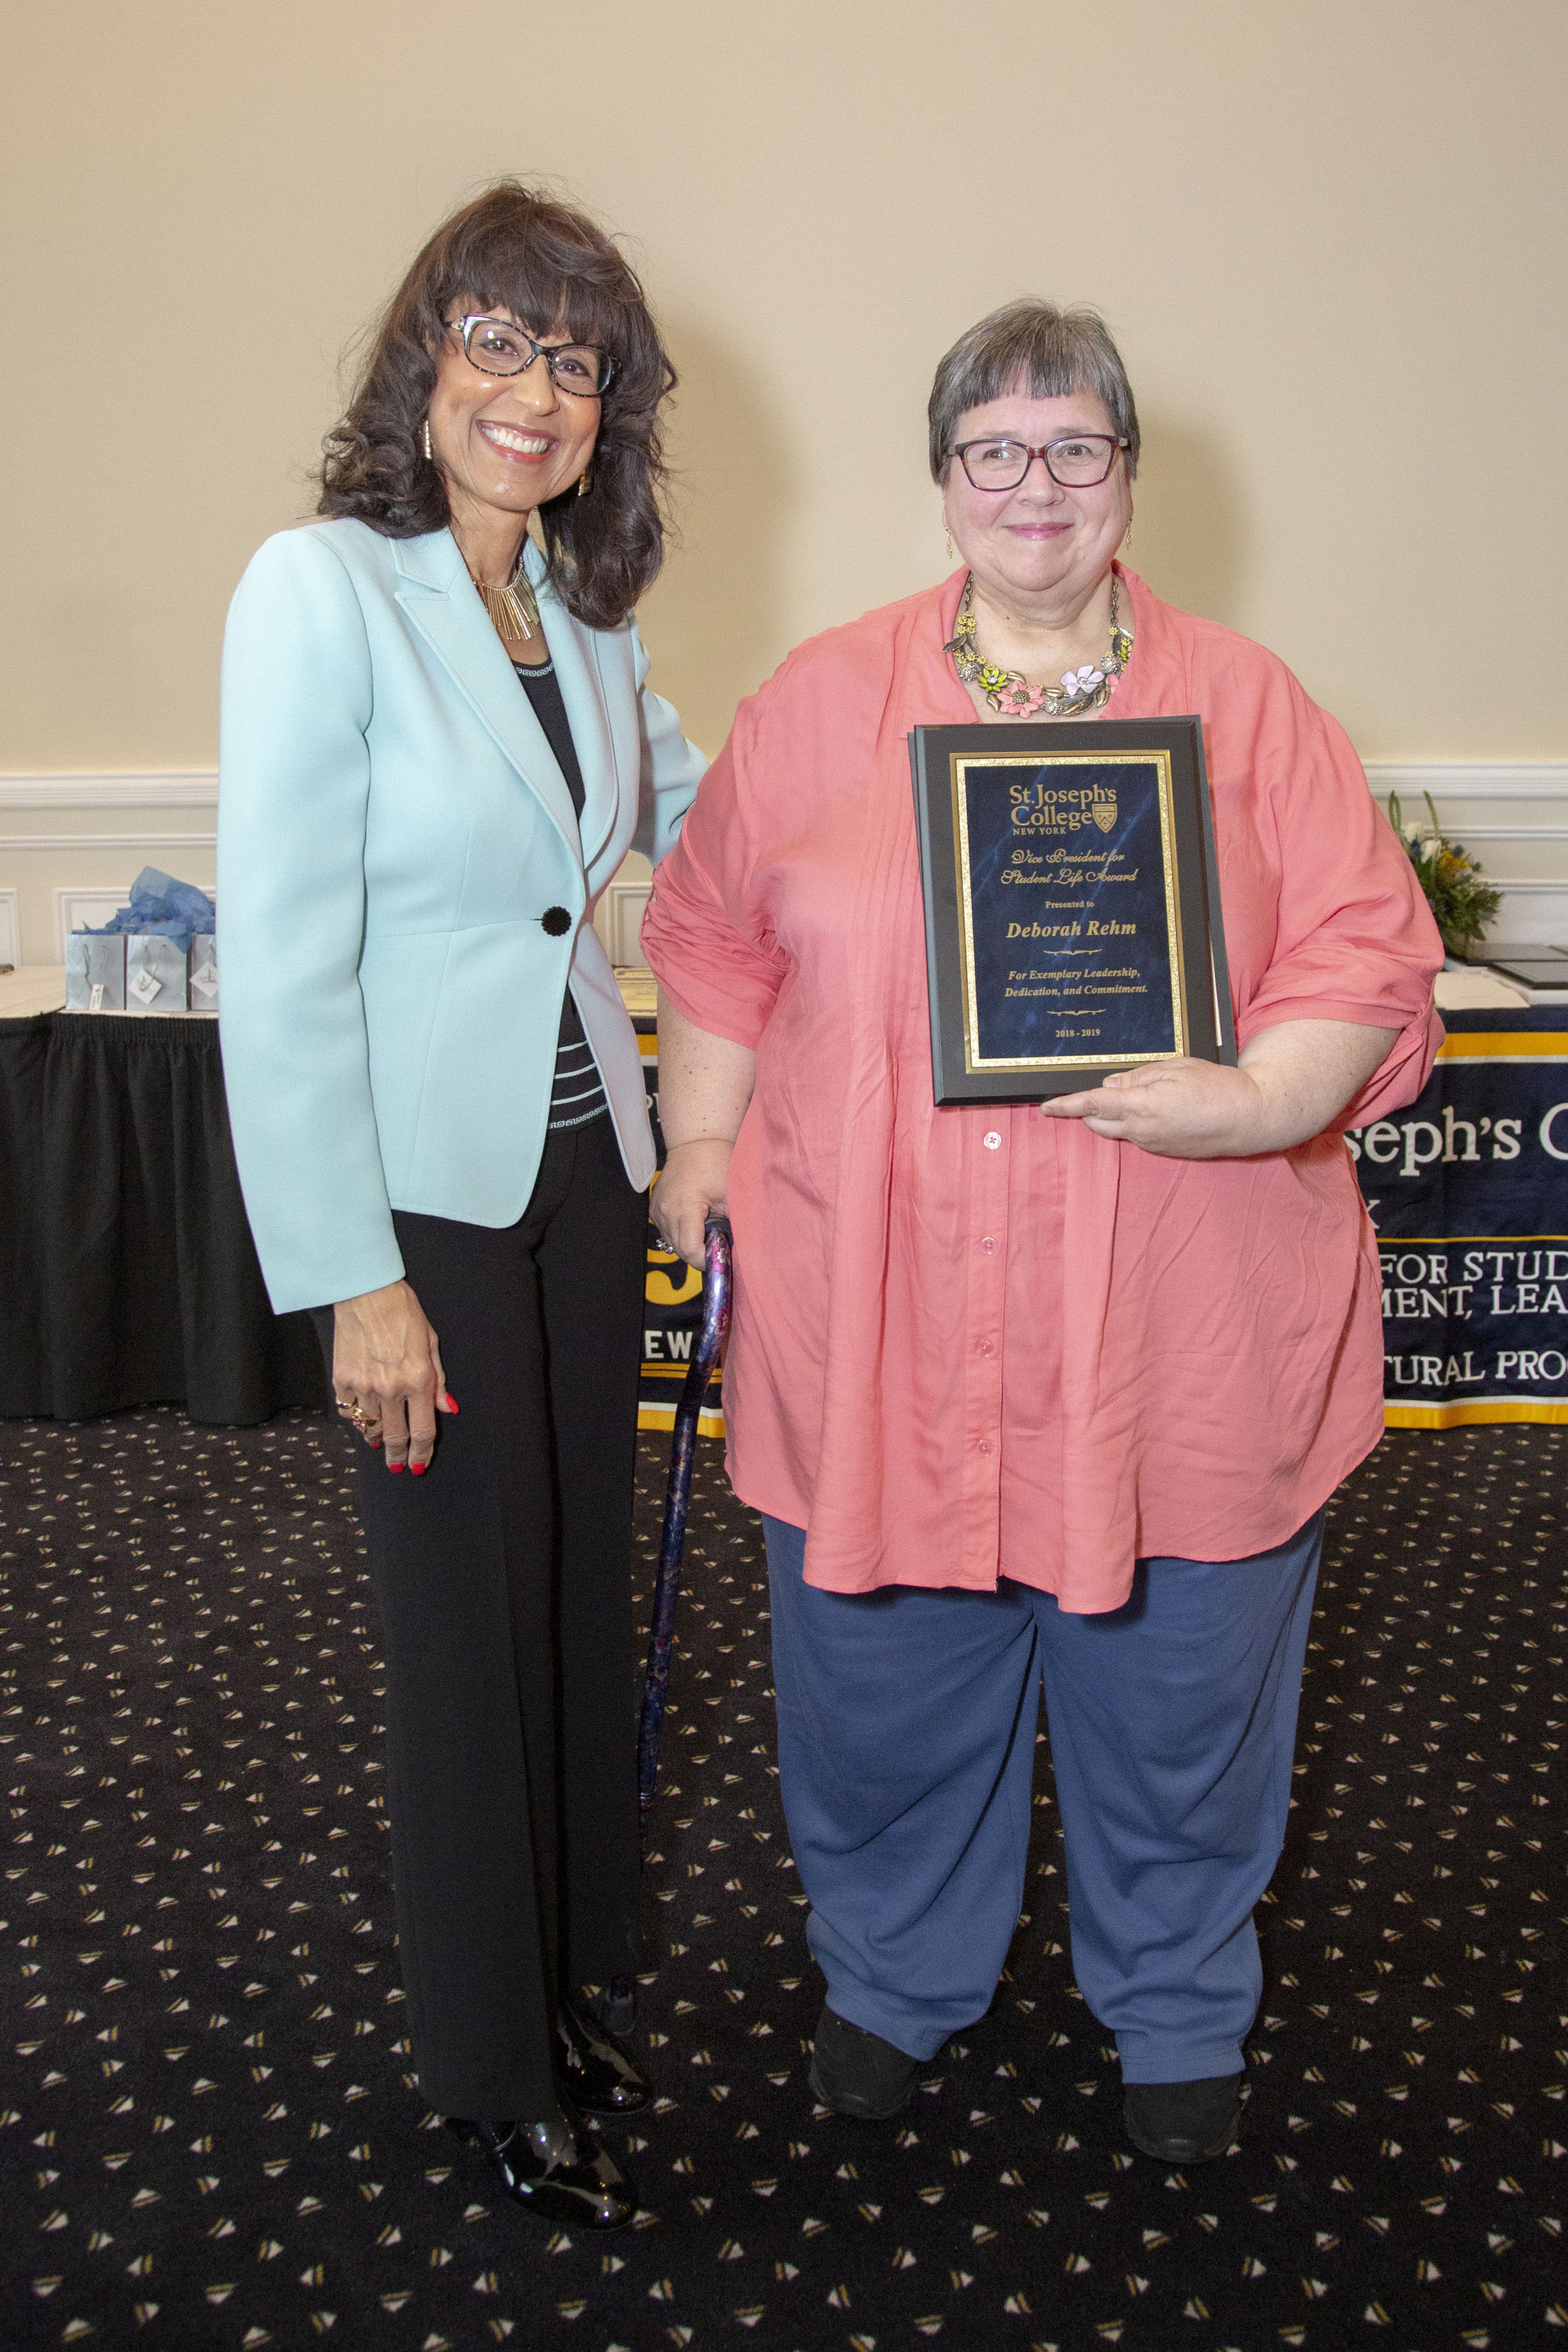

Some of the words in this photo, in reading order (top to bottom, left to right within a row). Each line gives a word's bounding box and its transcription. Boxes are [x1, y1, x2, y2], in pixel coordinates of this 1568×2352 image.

[1035, 784, 1117, 809] Joseph's
[1011, 805, 1093, 831] College
[1013, 827, 1036, 835] NEW
[1040, 826, 1067, 835] YORK
[1011, 849, 1043, 864] Vice
[1046, 849, 1107, 863] President
[1105, 849, 1125, 866] for
[1000, 869, 1054, 884] Student
[1054, 868, 1084, 888] Life
[1085, 867, 1139, 882] Award
[1006, 921, 1082, 938] Deborah
[1086, 920, 1137, 936] Rehm
[1009, 970, 1027, 980] For
[1028, 969, 1082, 981] Exemplary
[1084, 968, 1141, 978] Leadership,
[1004, 987, 1061, 997] Dedication,
[1063, 986, 1082, 995] and
[1084, 985, 1148, 995] Commitment.
[1055, 1029, 1075, 1038] 2018
[1081, 1028, 1101, 1037] 2019
[1379, 1254, 1448, 1285] FOR
[1463, 1250, 1568, 1281] STUD
[1490, 1284, 1568, 1315] LEA
[1383, 1351, 1486, 1387] URAL
